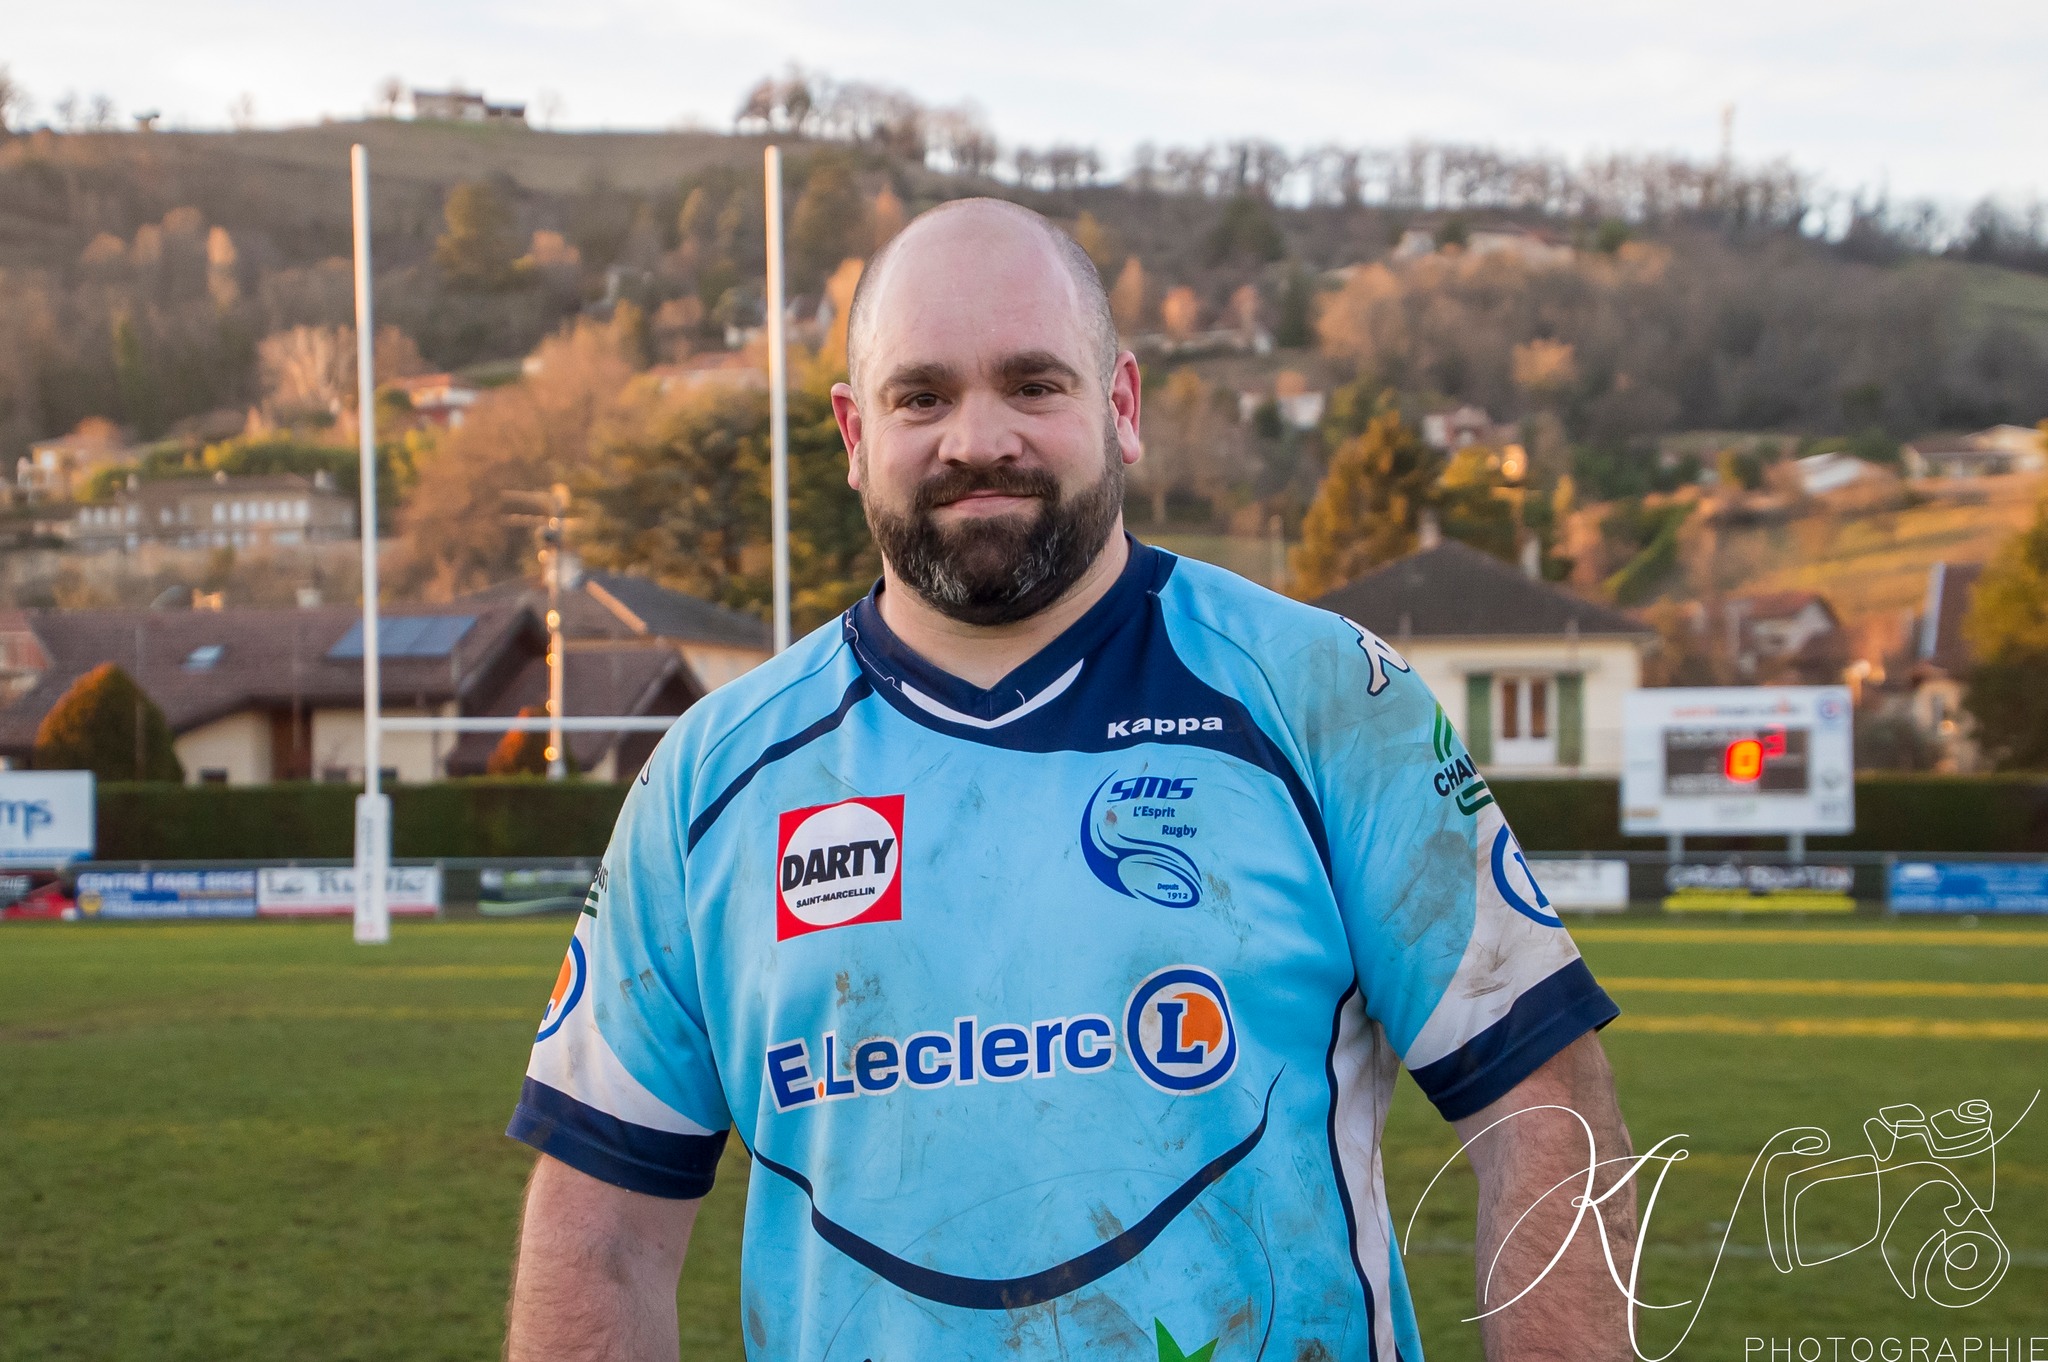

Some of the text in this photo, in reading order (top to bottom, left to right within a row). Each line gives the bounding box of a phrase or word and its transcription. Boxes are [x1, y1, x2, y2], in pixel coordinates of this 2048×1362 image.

[1107, 717, 1223, 739] Kappa
[1133, 806, 1175, 819] L'Esprit
[1161, 824, 1197, 838] Rugby
[782, 838, 895, 892] DARTY
[796, 887, 875, 908] SAINT-MARCELLIN
[767, 1016, 1112, 1108] E.Leclerc
